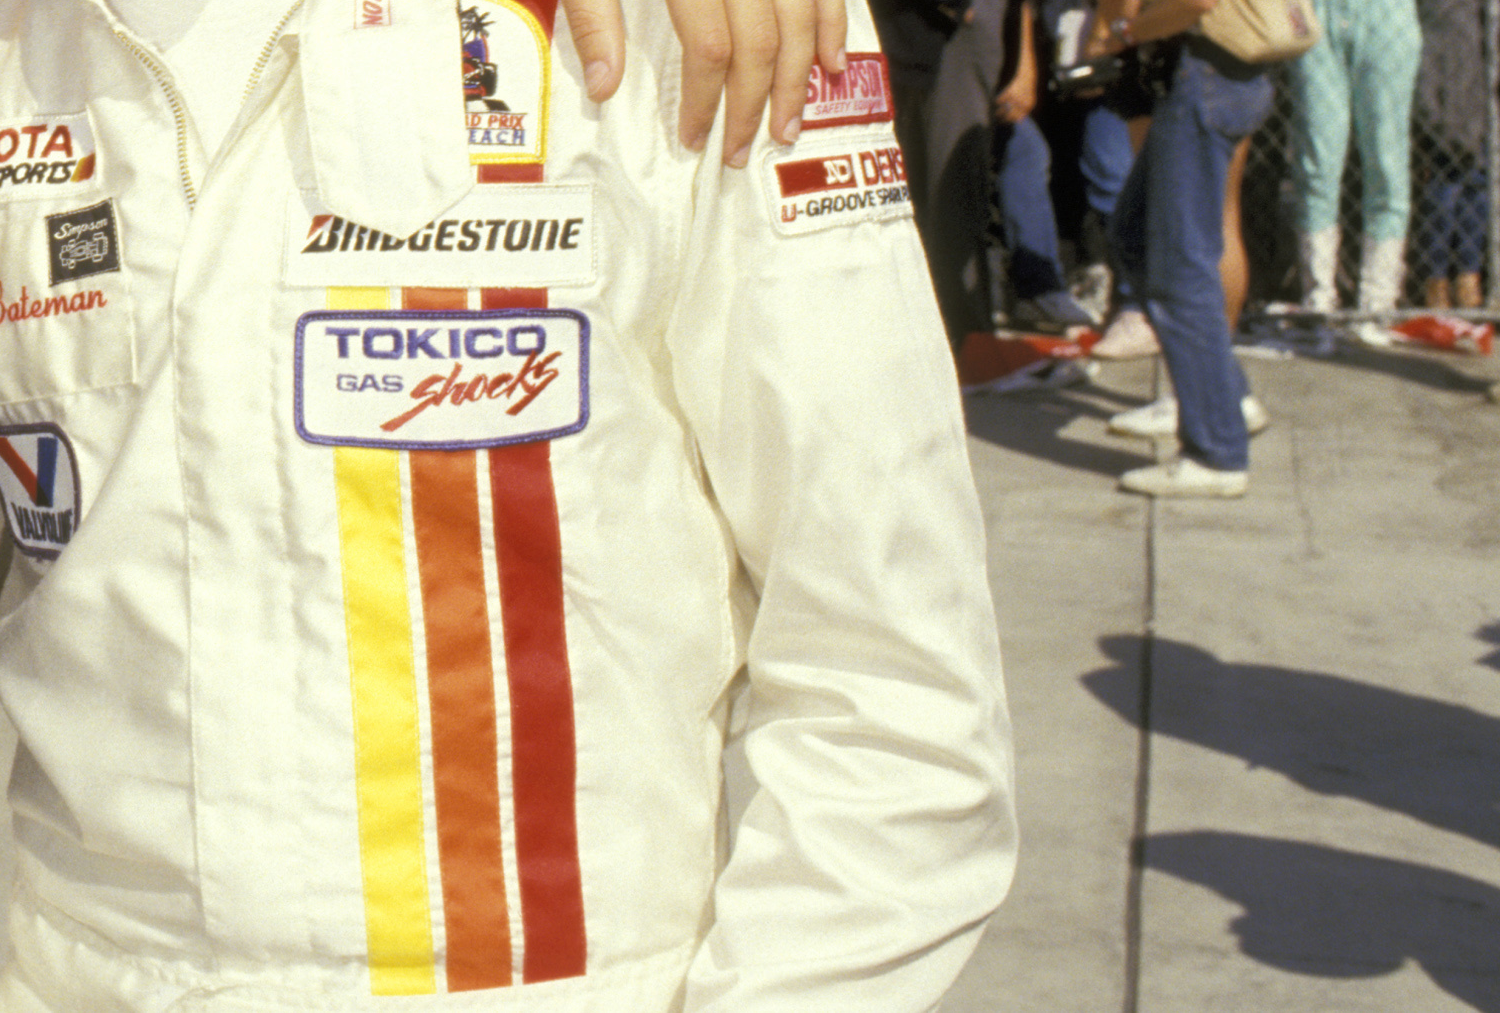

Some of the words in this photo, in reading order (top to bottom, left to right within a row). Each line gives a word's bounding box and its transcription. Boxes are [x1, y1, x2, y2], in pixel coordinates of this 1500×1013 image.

[488, 114, 525, 130] PRIX
[53, 217, 108, 240] Simpson
[325, 324, 547, 361] TOKICO
[336, 373, 404, 393] GAS
